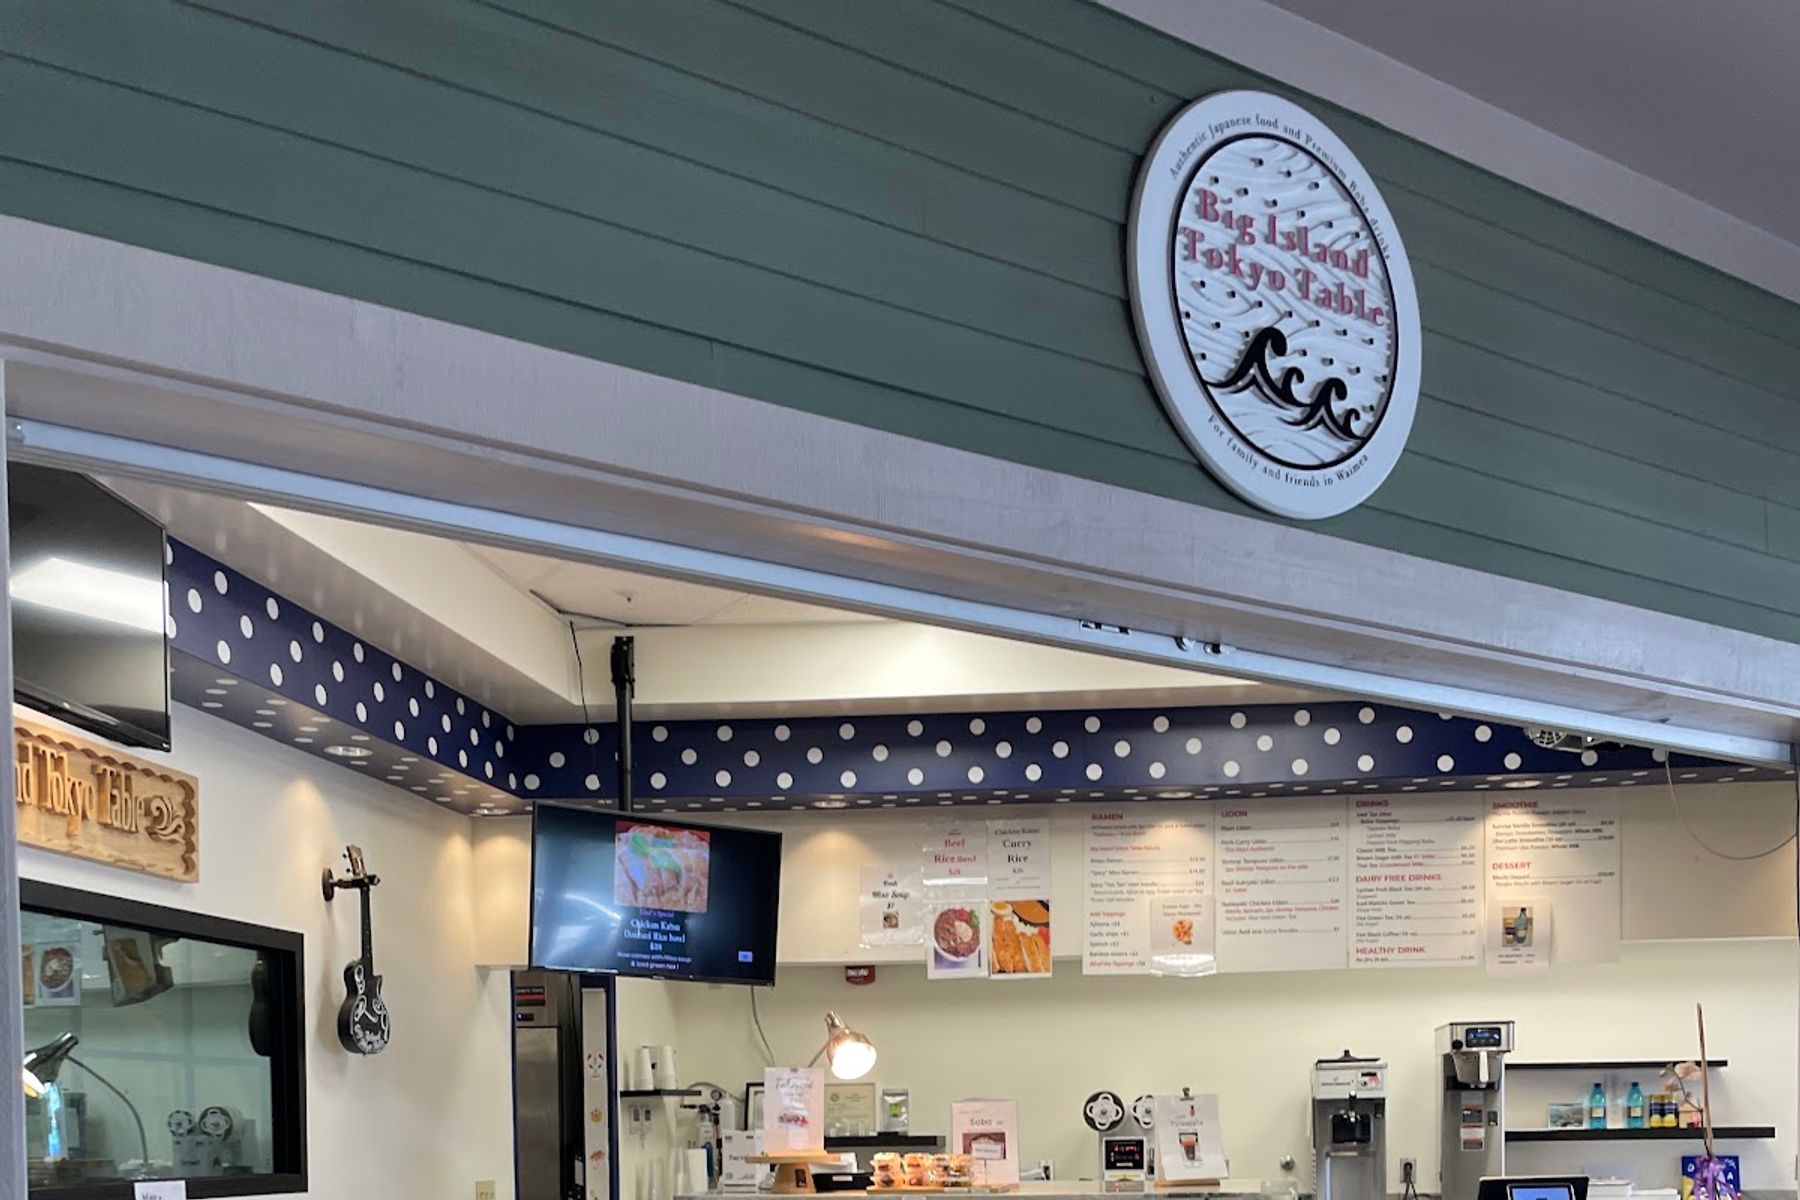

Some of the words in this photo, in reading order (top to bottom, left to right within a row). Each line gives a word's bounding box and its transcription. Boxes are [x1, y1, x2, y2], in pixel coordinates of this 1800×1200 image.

[1169, 131, 1208, 181] Authentic
[1208, 116, 1252, 140] Japanese
[1256, 113, 1279, 128] food
[1283, 125, 1301, 140] and
[1305, 134, 1347, 181] Premium
[1197, 187, 1256, 246] Big
[1264, 213, 1369, 279] Island
[1179, 226, 1286, 291] Tokyo
[1294, 267, 1385, 327] Table
[1208, 413, 1224, 437] For
[1226, 437, 1258, 469] family
[1263, 466, 1281, 480] and
[1285, 471, 1320, 488] friends
[1323, 476, 1333, 487] in
[1336, 453, 1369, 481] Waimea
[37, 744, 97, 828] Tokyo
[99, 763, 145, 833] Table
[1492, 801, 1539, 809] SMOOTHIE
[1221, 810, 1248, 818] UDON
[944, 838, 966, 848] Beef
[1002, 838, 1033, 849] Curry
[934, 854, 954, 864] Rice
[1007, 853, 1029, 864] Rice
[1492, 862, 1531, 870] DESSERT
[1356, 875, 1383, 883] DAIRY
[1385, 874, 1406, 882] FREE
[1408, 873, 1441, 881] DRINKS
[653, 931, 668, 941] Rice
[669, 932, 685, 943] bowl
